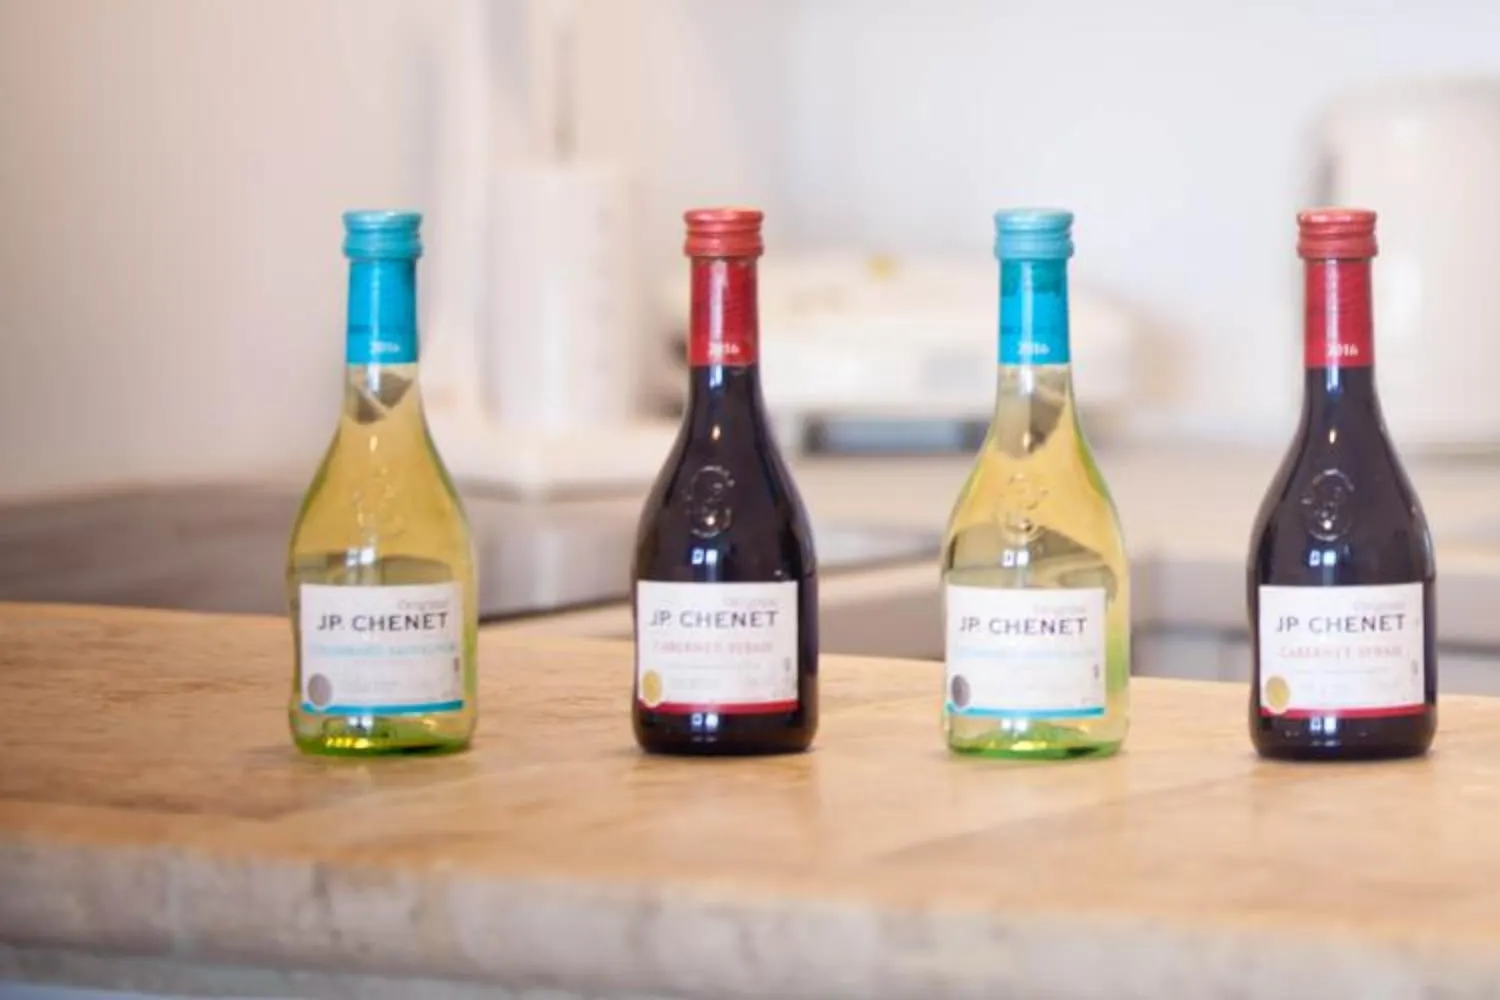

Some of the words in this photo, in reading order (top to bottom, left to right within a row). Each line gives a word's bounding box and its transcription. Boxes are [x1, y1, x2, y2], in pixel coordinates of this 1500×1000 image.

[352, 612, 448, 632] CHENET
[679, 610, 779, 628] CHENET
[988, 617, 1088, 635] CHENET
[1308, 614, 1406, 634] CHENET
